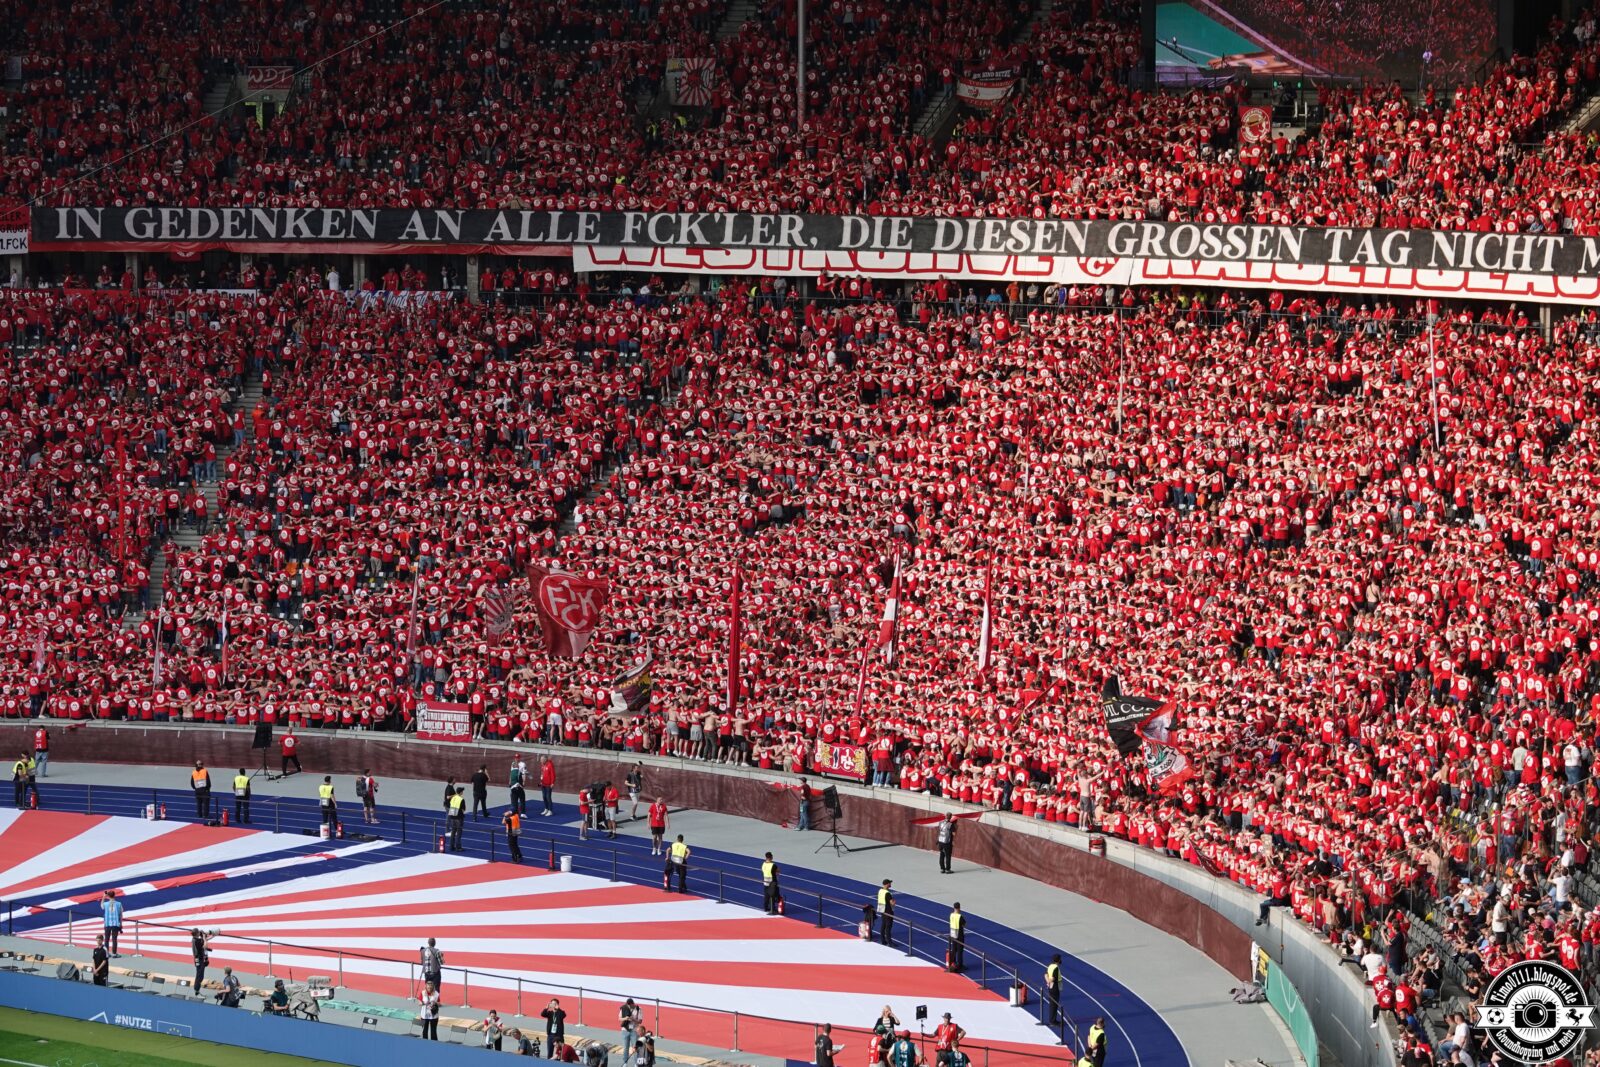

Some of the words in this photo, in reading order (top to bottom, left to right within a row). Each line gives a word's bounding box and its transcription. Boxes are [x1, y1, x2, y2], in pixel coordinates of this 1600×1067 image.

[55, 207, 105, 239] IN
[124, 207, 378, 240] GEDENKEN
[398, 209, 466, 241] AN
[483, 210, 601, 244] ALLE
[619, 211, 819, 249] FCK'LER,
[838, 215, 914, 251] DIE
[930, 218, 1093, 255] DIESEN
[1107, 221, 1309, 262] GROSSEN
[1324, 228, 1413, 266] TAG
[1427, 230, 1565, 273] NICHT
[114, 1014, 153, 1029] #NUTZE
